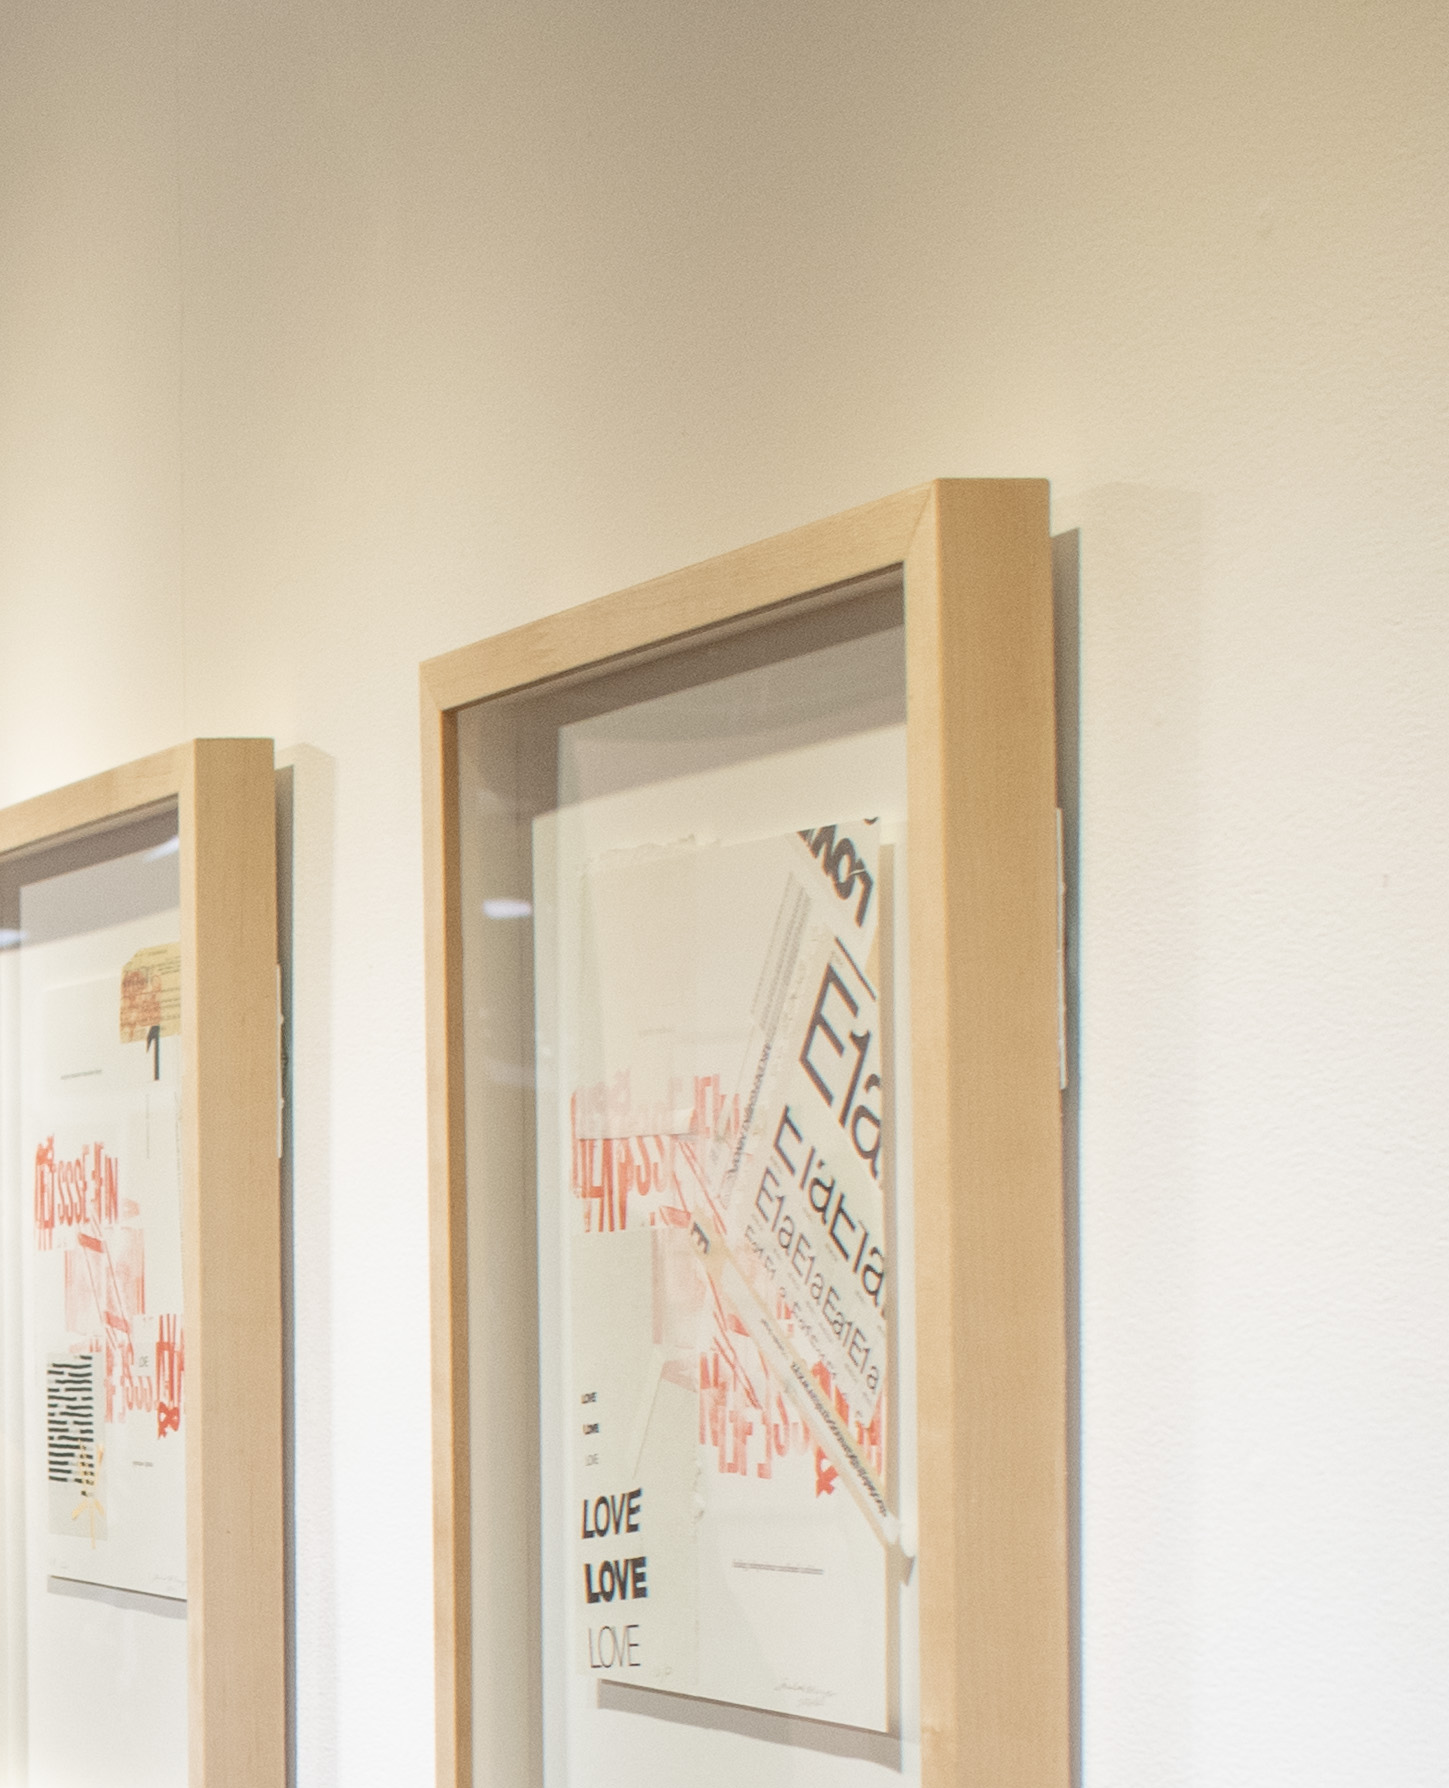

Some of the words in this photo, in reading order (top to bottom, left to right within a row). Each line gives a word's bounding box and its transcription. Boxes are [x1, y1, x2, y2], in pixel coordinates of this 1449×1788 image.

[581, 1487, 643, 1539] LOVE
[583, 1556, 649, 1604] LOVE
[588, 1623, 642, 1668] LOVE
